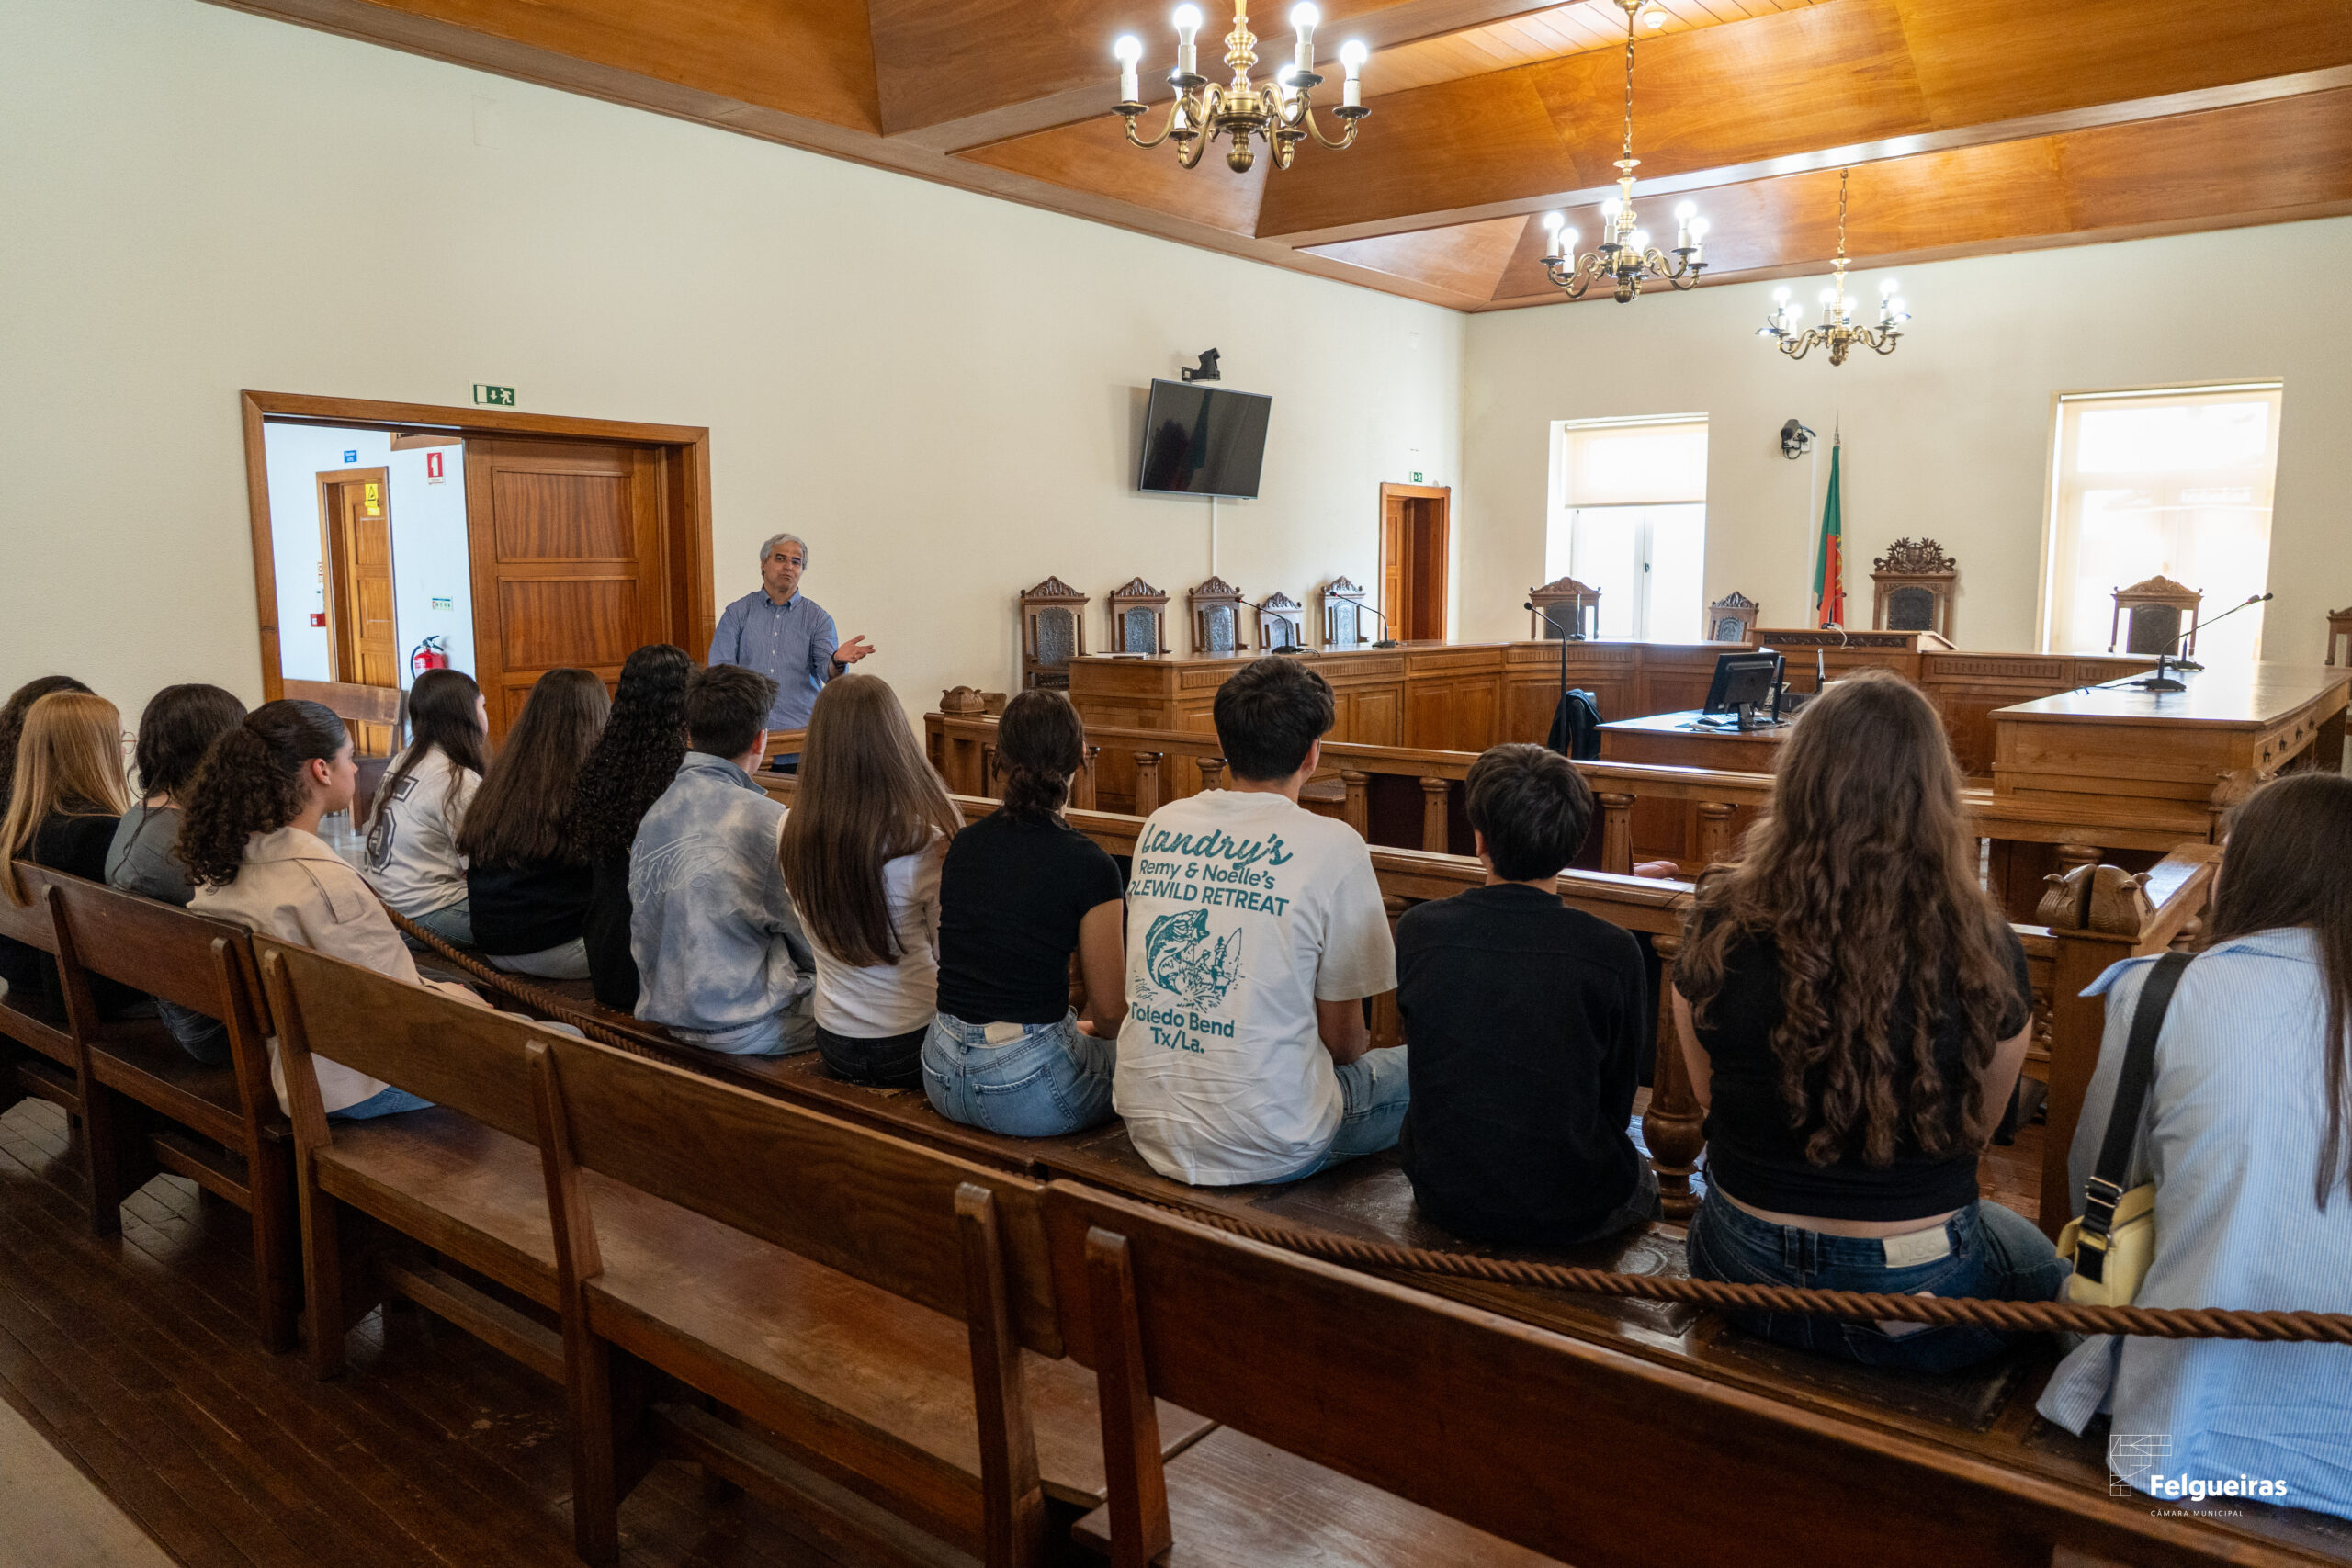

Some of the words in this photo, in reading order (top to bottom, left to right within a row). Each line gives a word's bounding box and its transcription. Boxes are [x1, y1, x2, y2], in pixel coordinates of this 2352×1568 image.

[1141, 823, 1294, 871] Landry's
[1139, 859, 1182, 880] Remy
[1184, 862, 1199, 878] &
[1201, 886, 1290, 917] RETREAT
[1131, 1001, 1185, 1028] Toledo
[1189, 1011, 1235, 1038] Bend
[1149, 1026, 1205, 1054] Tx/La.
